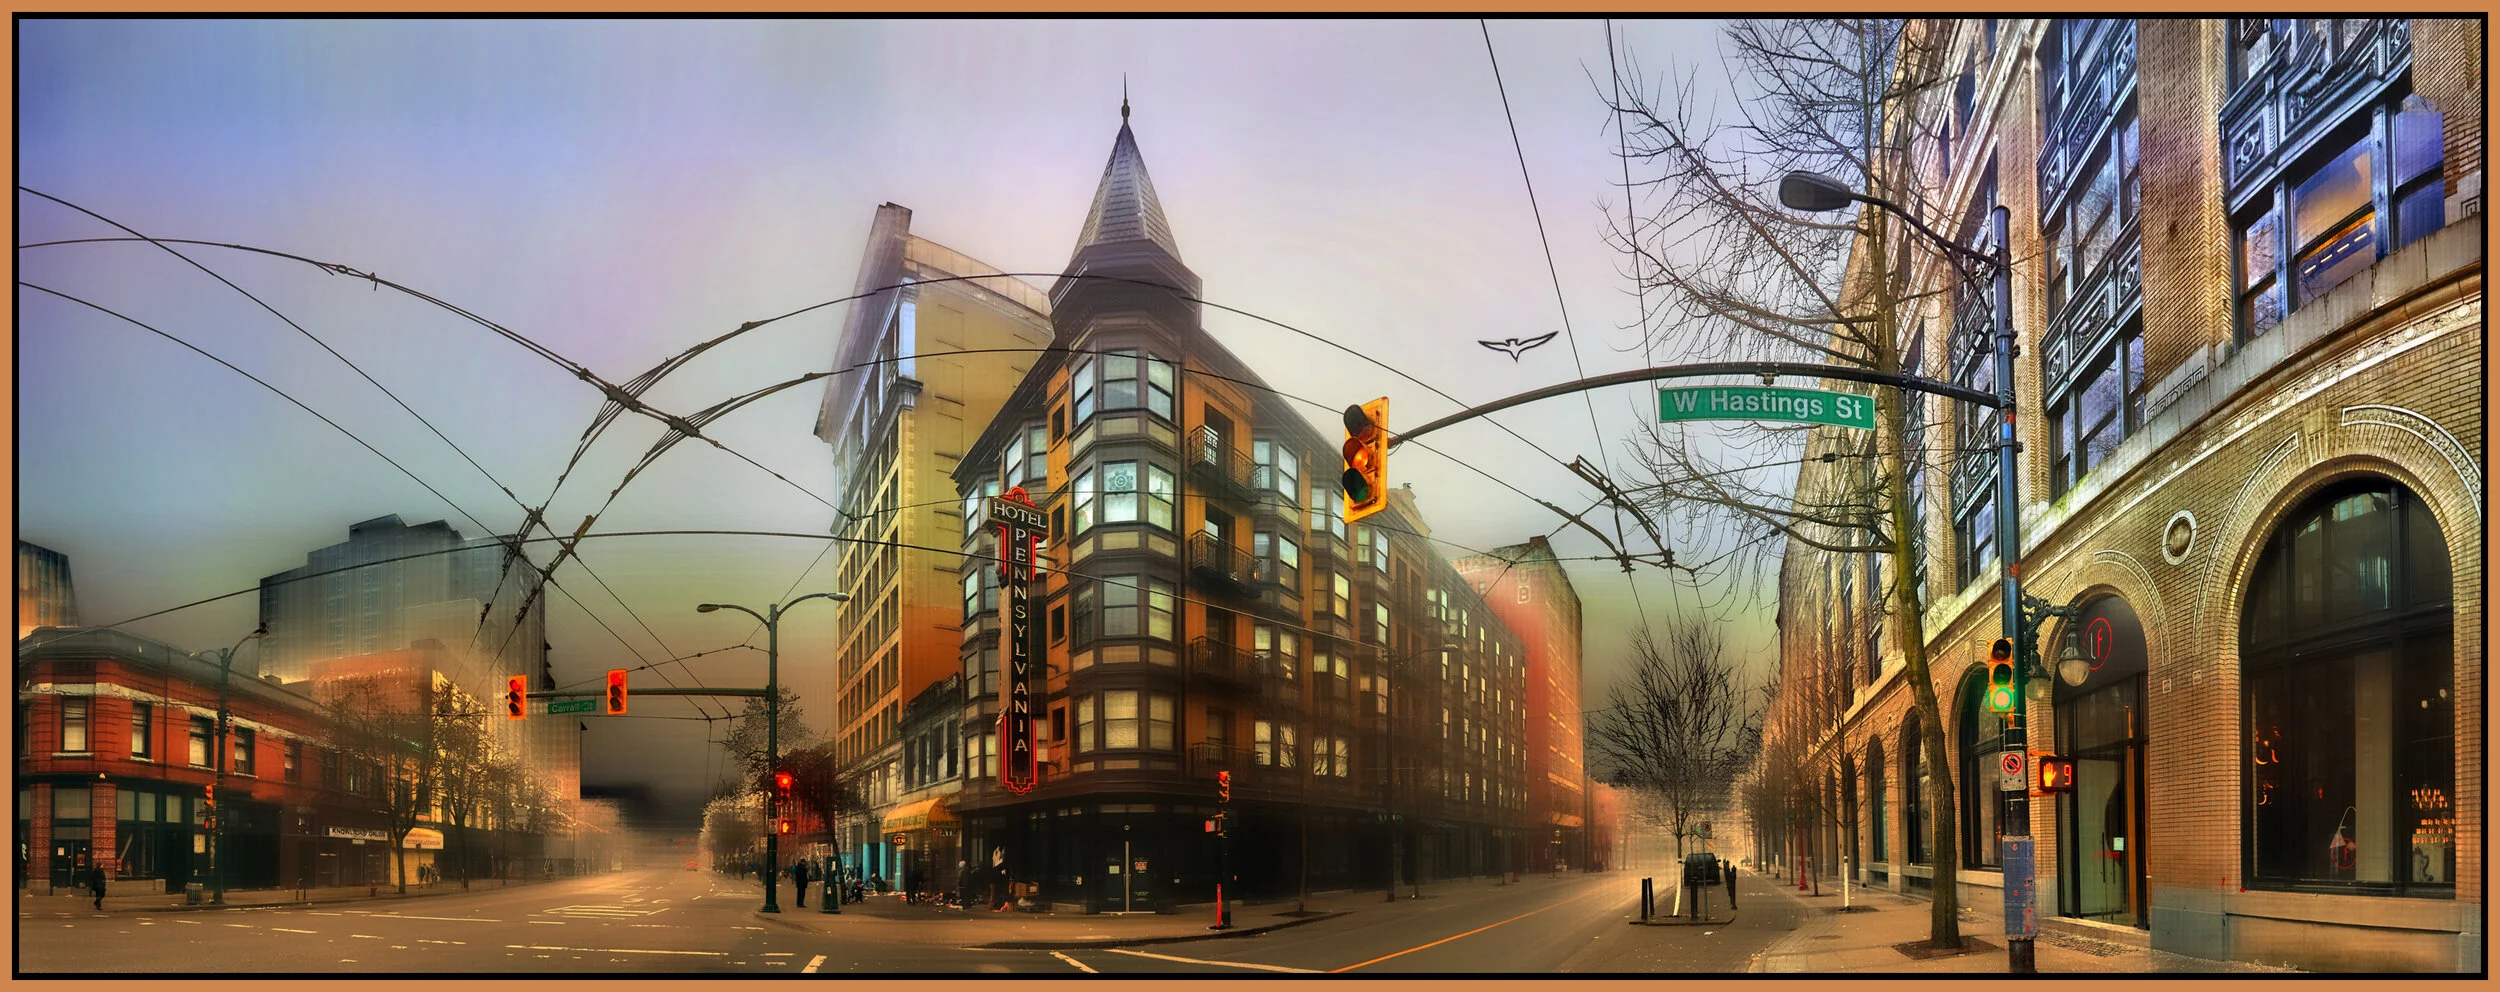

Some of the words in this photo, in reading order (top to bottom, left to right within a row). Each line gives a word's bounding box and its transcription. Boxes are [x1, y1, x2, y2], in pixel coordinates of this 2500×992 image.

[1672, 390, 1699, 412] W
[1710, 389, 1824, 418] Hastings
[1835, 396, 1863, 420] St
[993, 501, 1047, 528] HOTEL
[1014, 527, 1028, 752] PENNSYLVANIA
[583, 702, 594, 711] St
[2063, 764, 2073, 786] 9
[941, 829, 958, 837] ATM
